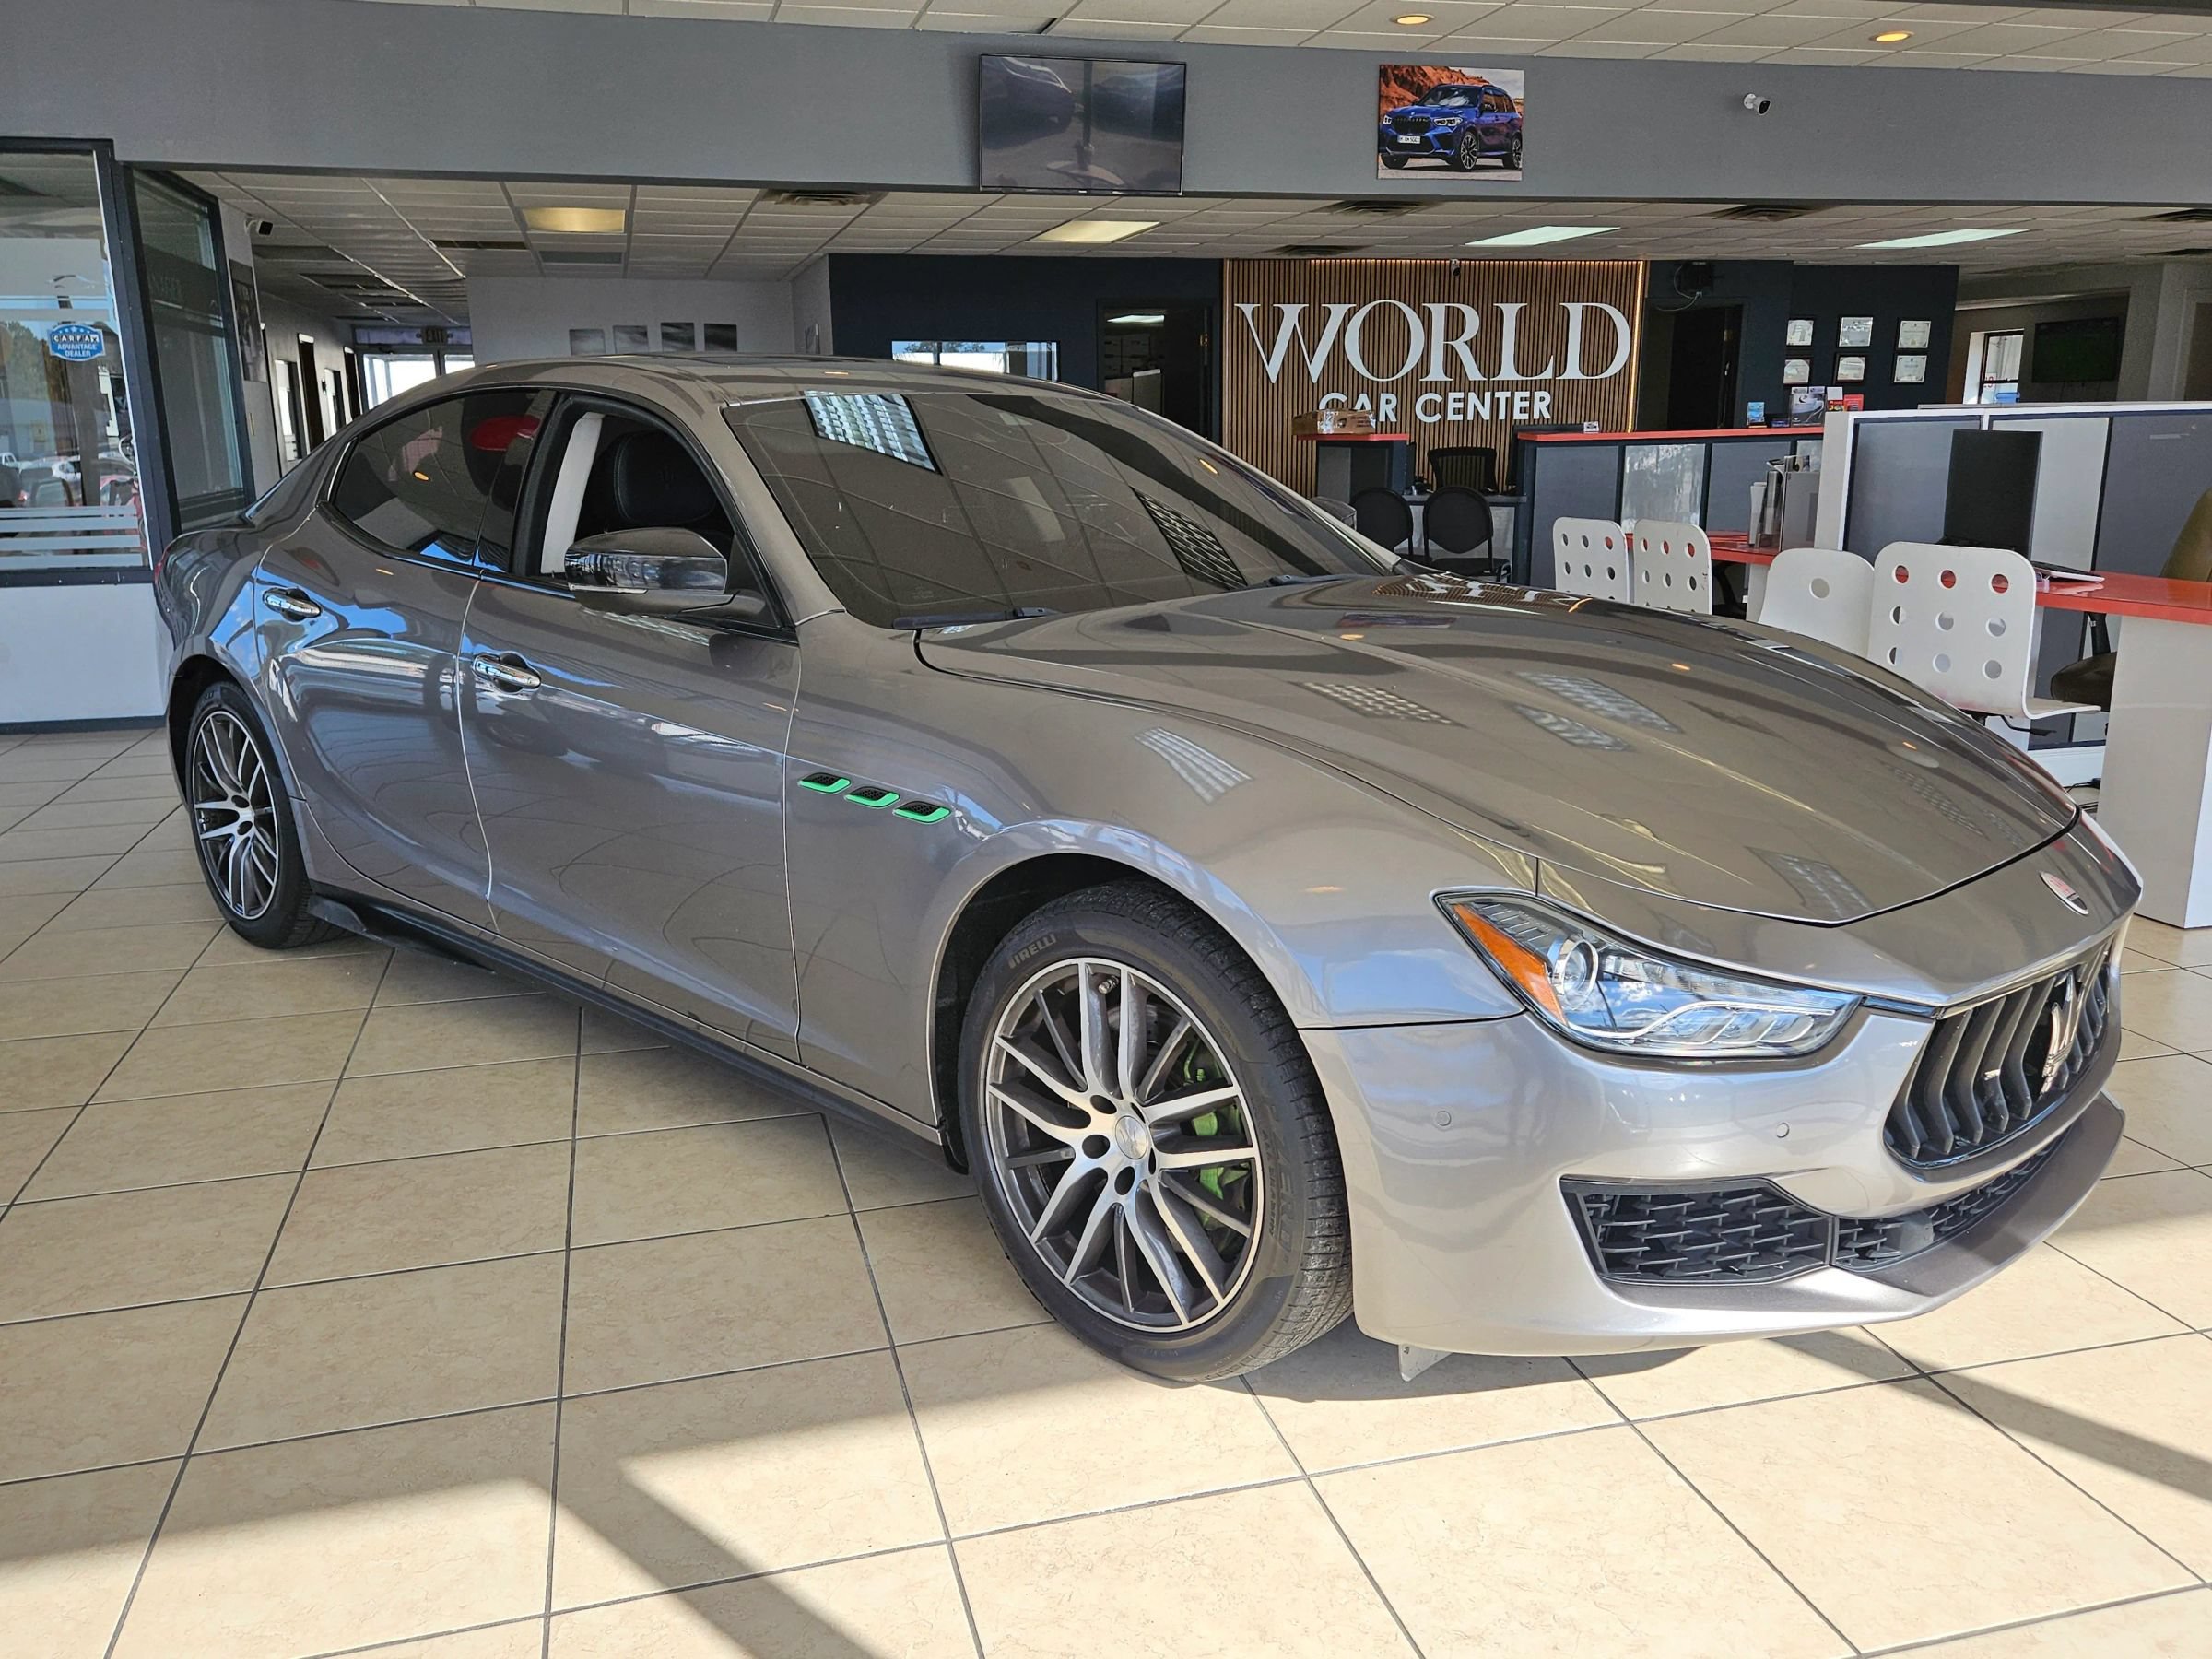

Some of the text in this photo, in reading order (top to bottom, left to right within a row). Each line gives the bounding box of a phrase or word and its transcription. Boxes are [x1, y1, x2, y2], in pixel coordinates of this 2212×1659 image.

[53, 335, 100, 343] CARFAX
[1234, 299, 1631, 384] WORLD
[1415, 390, 1551, 423] CENTER
